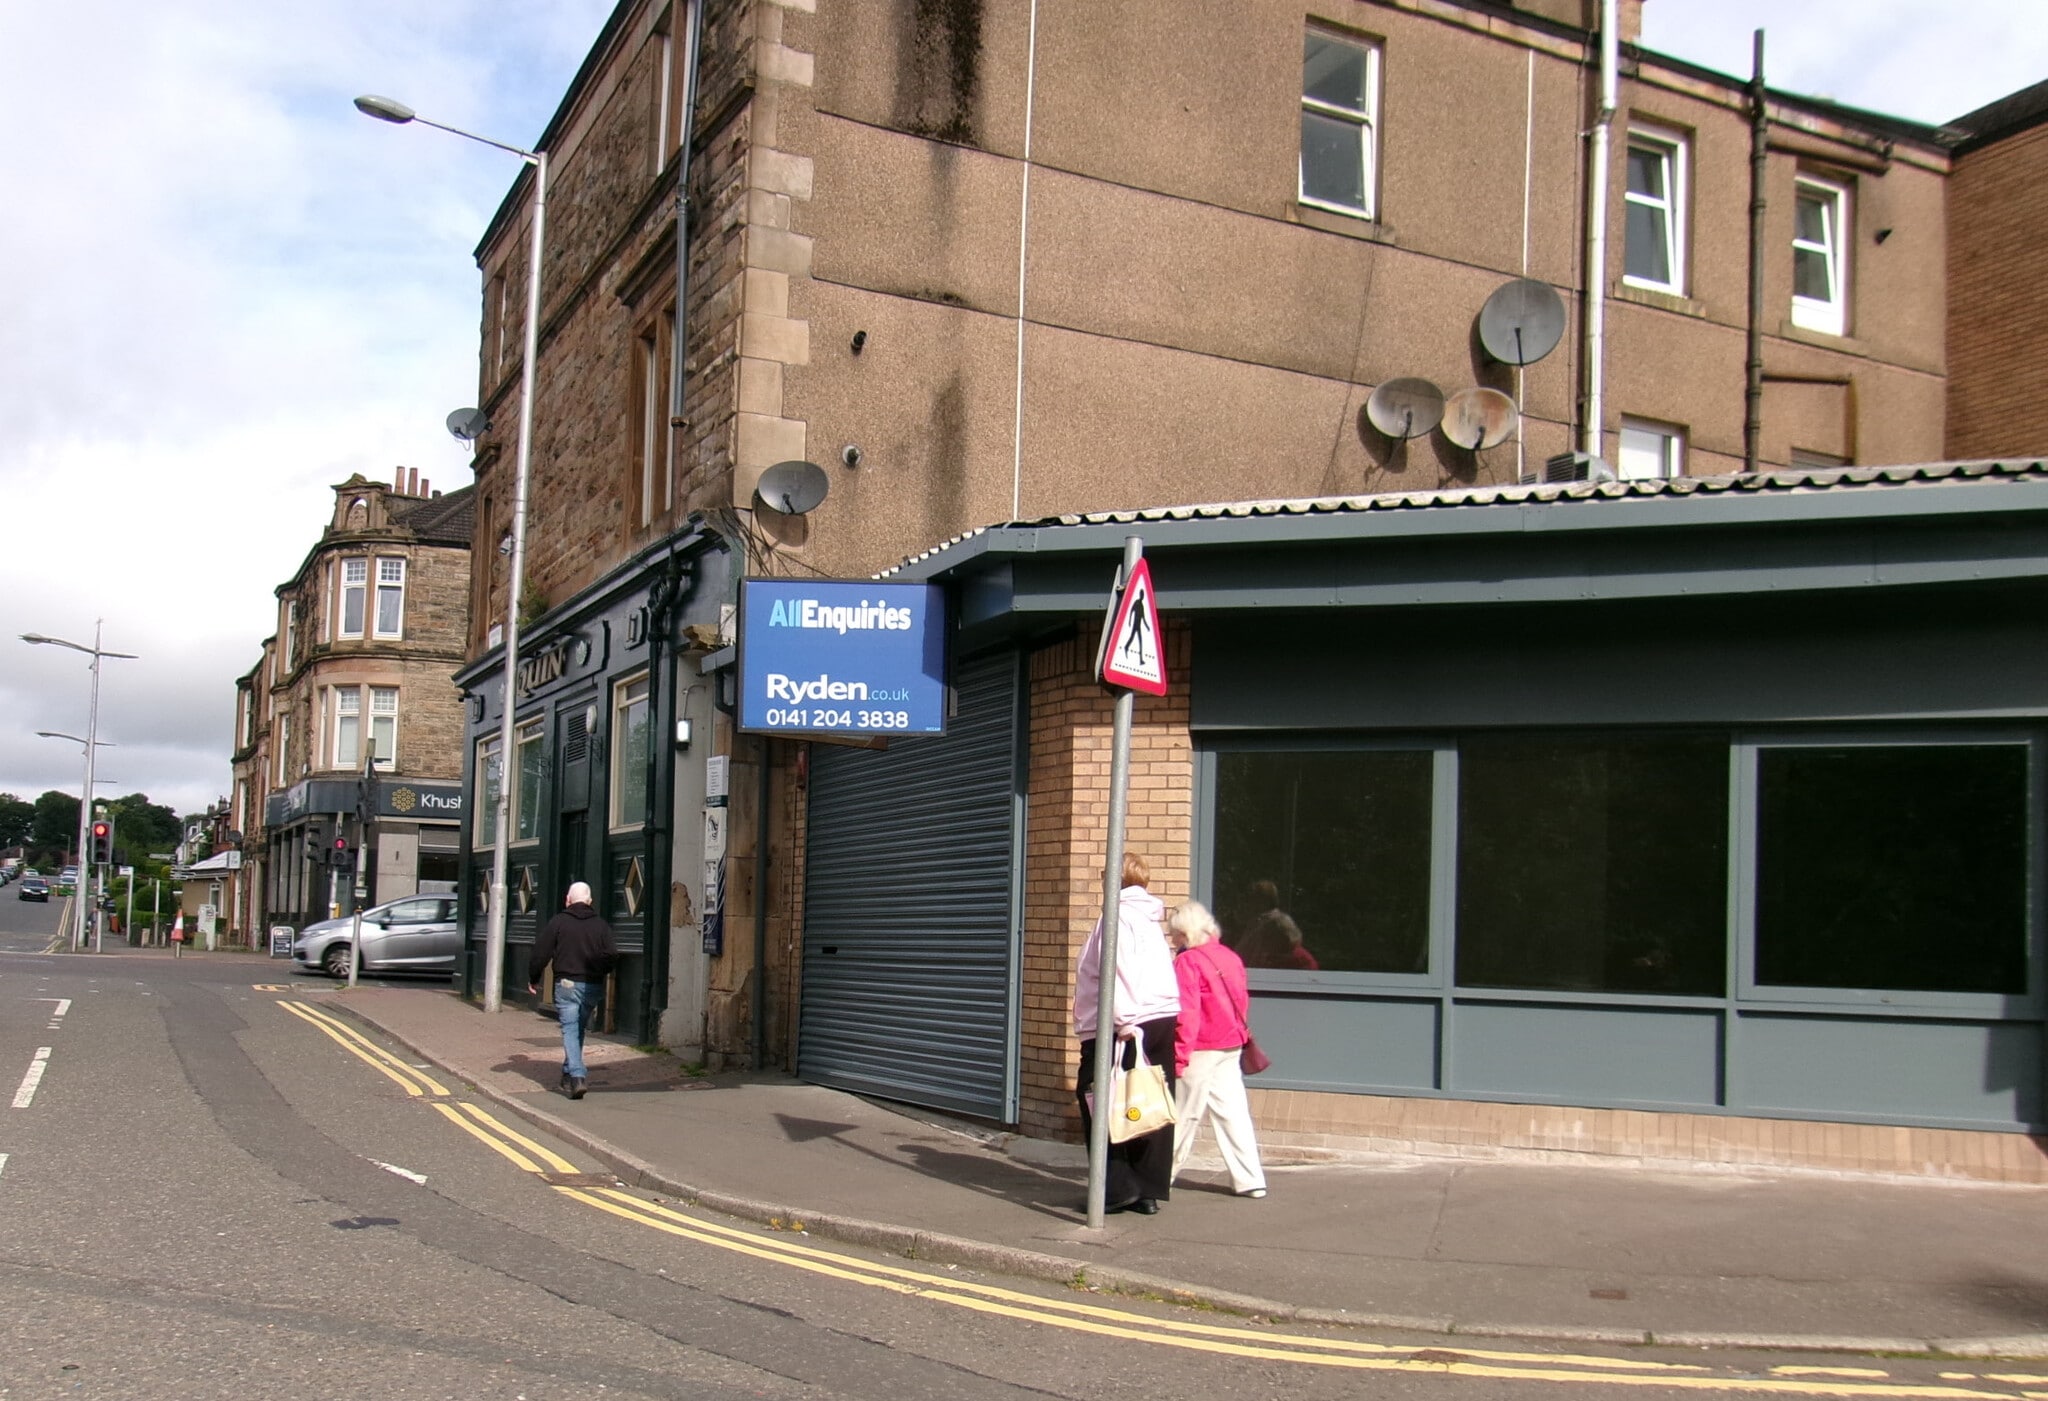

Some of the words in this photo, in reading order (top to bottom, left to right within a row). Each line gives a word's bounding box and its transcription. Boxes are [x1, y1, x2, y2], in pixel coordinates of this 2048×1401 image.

[769, 599, 912, 635] AllEnquiries
[767, 674, 910, 705] Ryden.co.uk
[766, 708, 808, 727] 0141
[813, 709, 852, 727] 204
[857, 710, 909, 728] 3838
